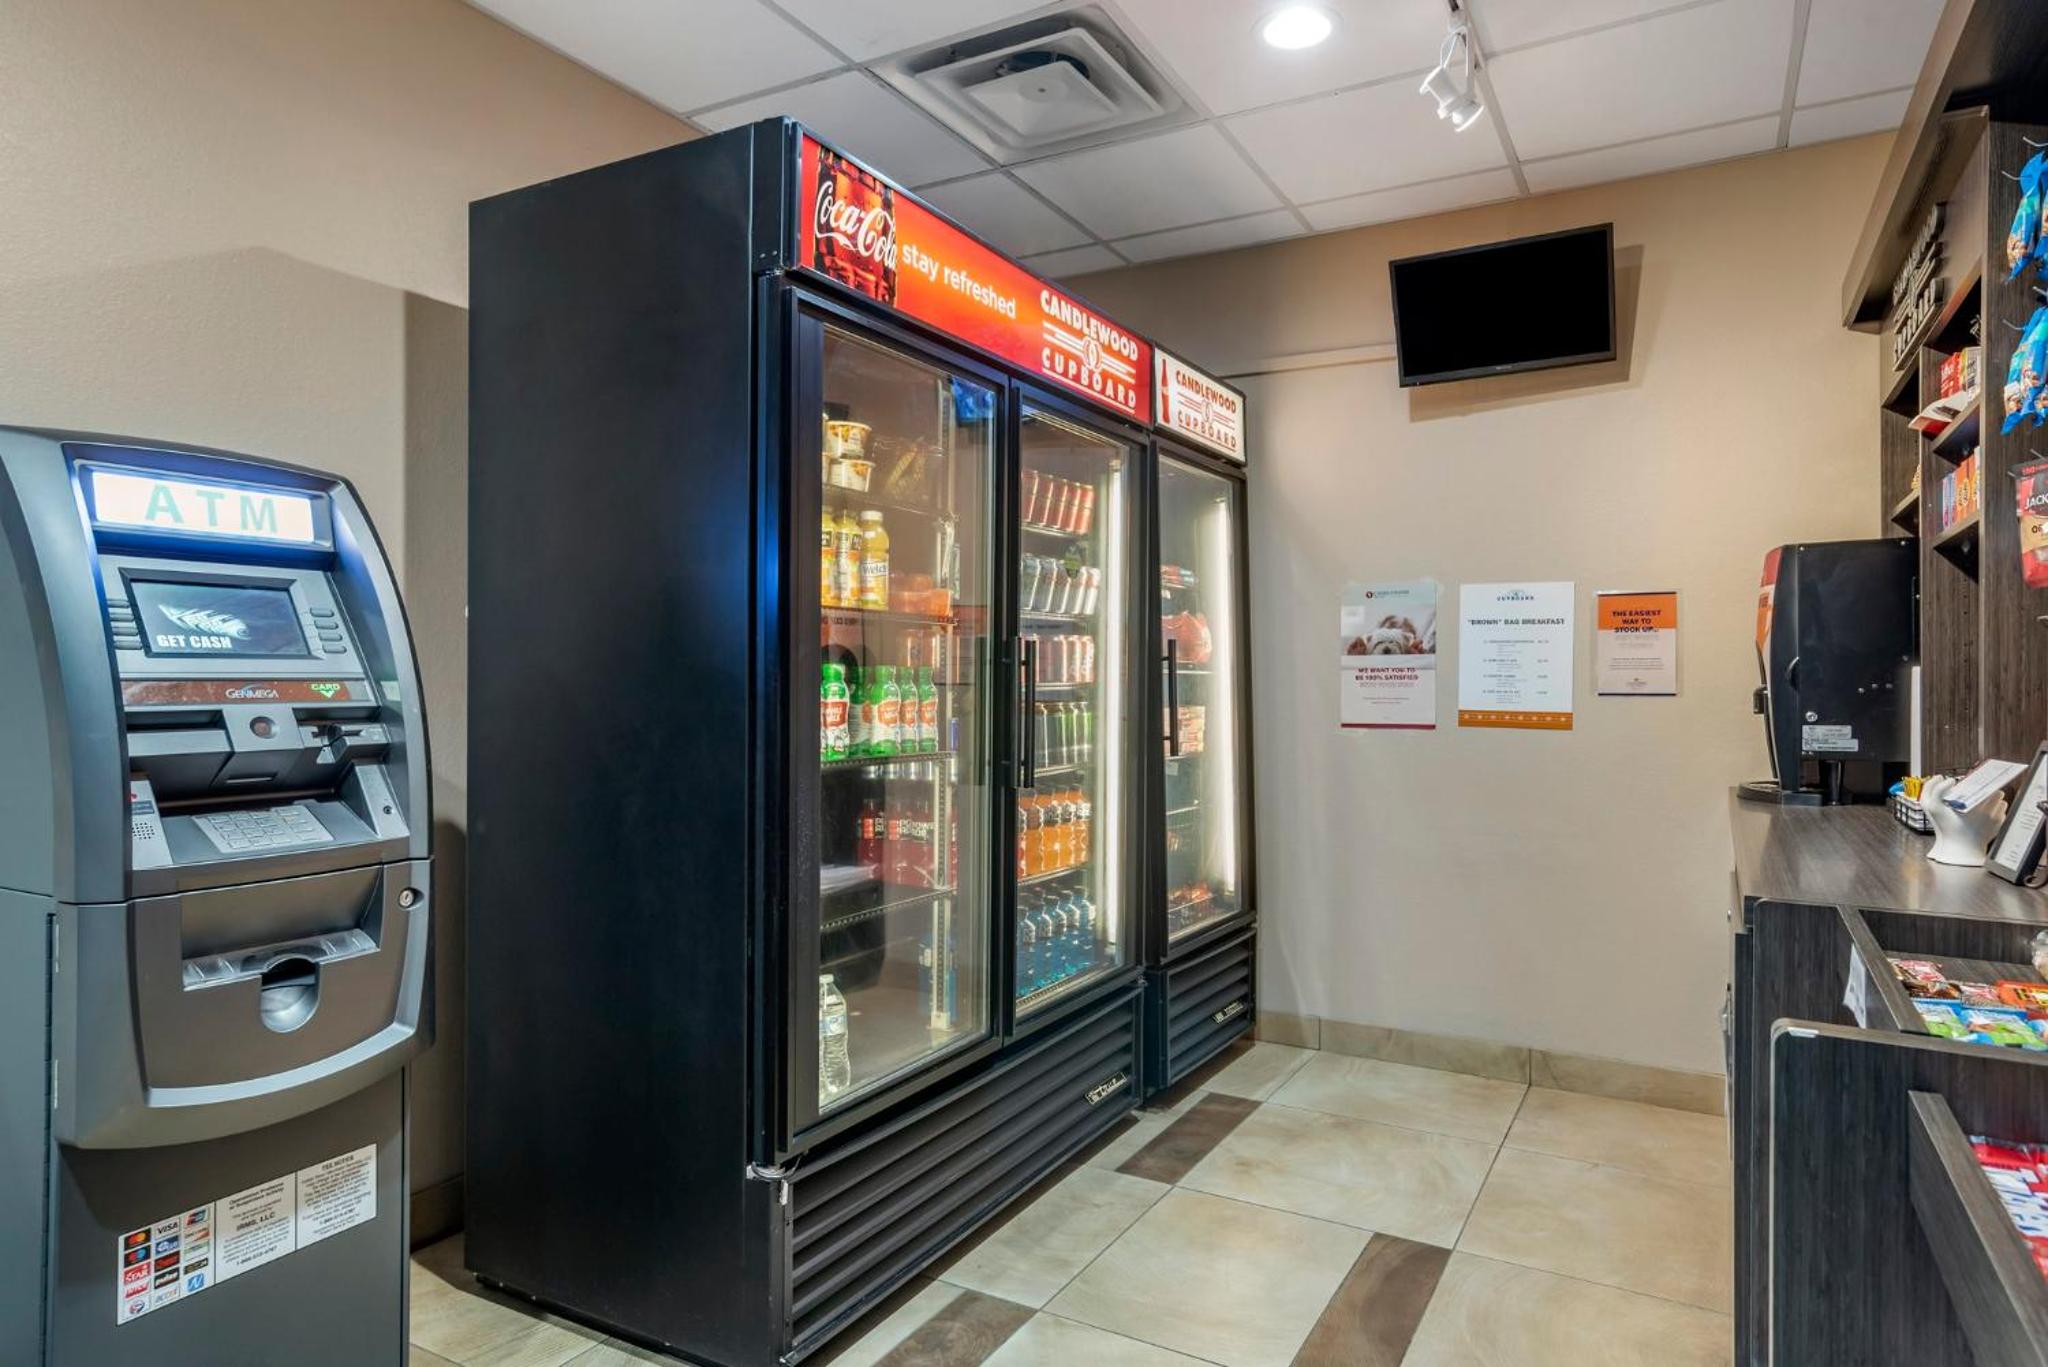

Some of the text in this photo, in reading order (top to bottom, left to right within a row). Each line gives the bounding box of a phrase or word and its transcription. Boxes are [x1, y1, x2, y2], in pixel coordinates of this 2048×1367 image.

[814, 181, 897, 271] Coca-Cola
[902, 244, 1016, 319] stay refreshed
[1040, 289, 1138, 362] CANDLEWOOD
[1042, 347, 1136, 408] CUPBOARD
[1175, 370, 1236, 414] CANDLEWOOD
[1177, 410, 1236, 449] CUPBOARD
[145, 484, 278, 534] ATM
[1521, 617, 1565, 625] BREAKFAST
[1628, 609, 1662, 617] EASIEST
[1641, 617, 1652, 625] TO
[156, 634, 233, 649] GET CASH
[311, 683, 341, 691] CARD
[156, 1221, 179, 1234] VISA
